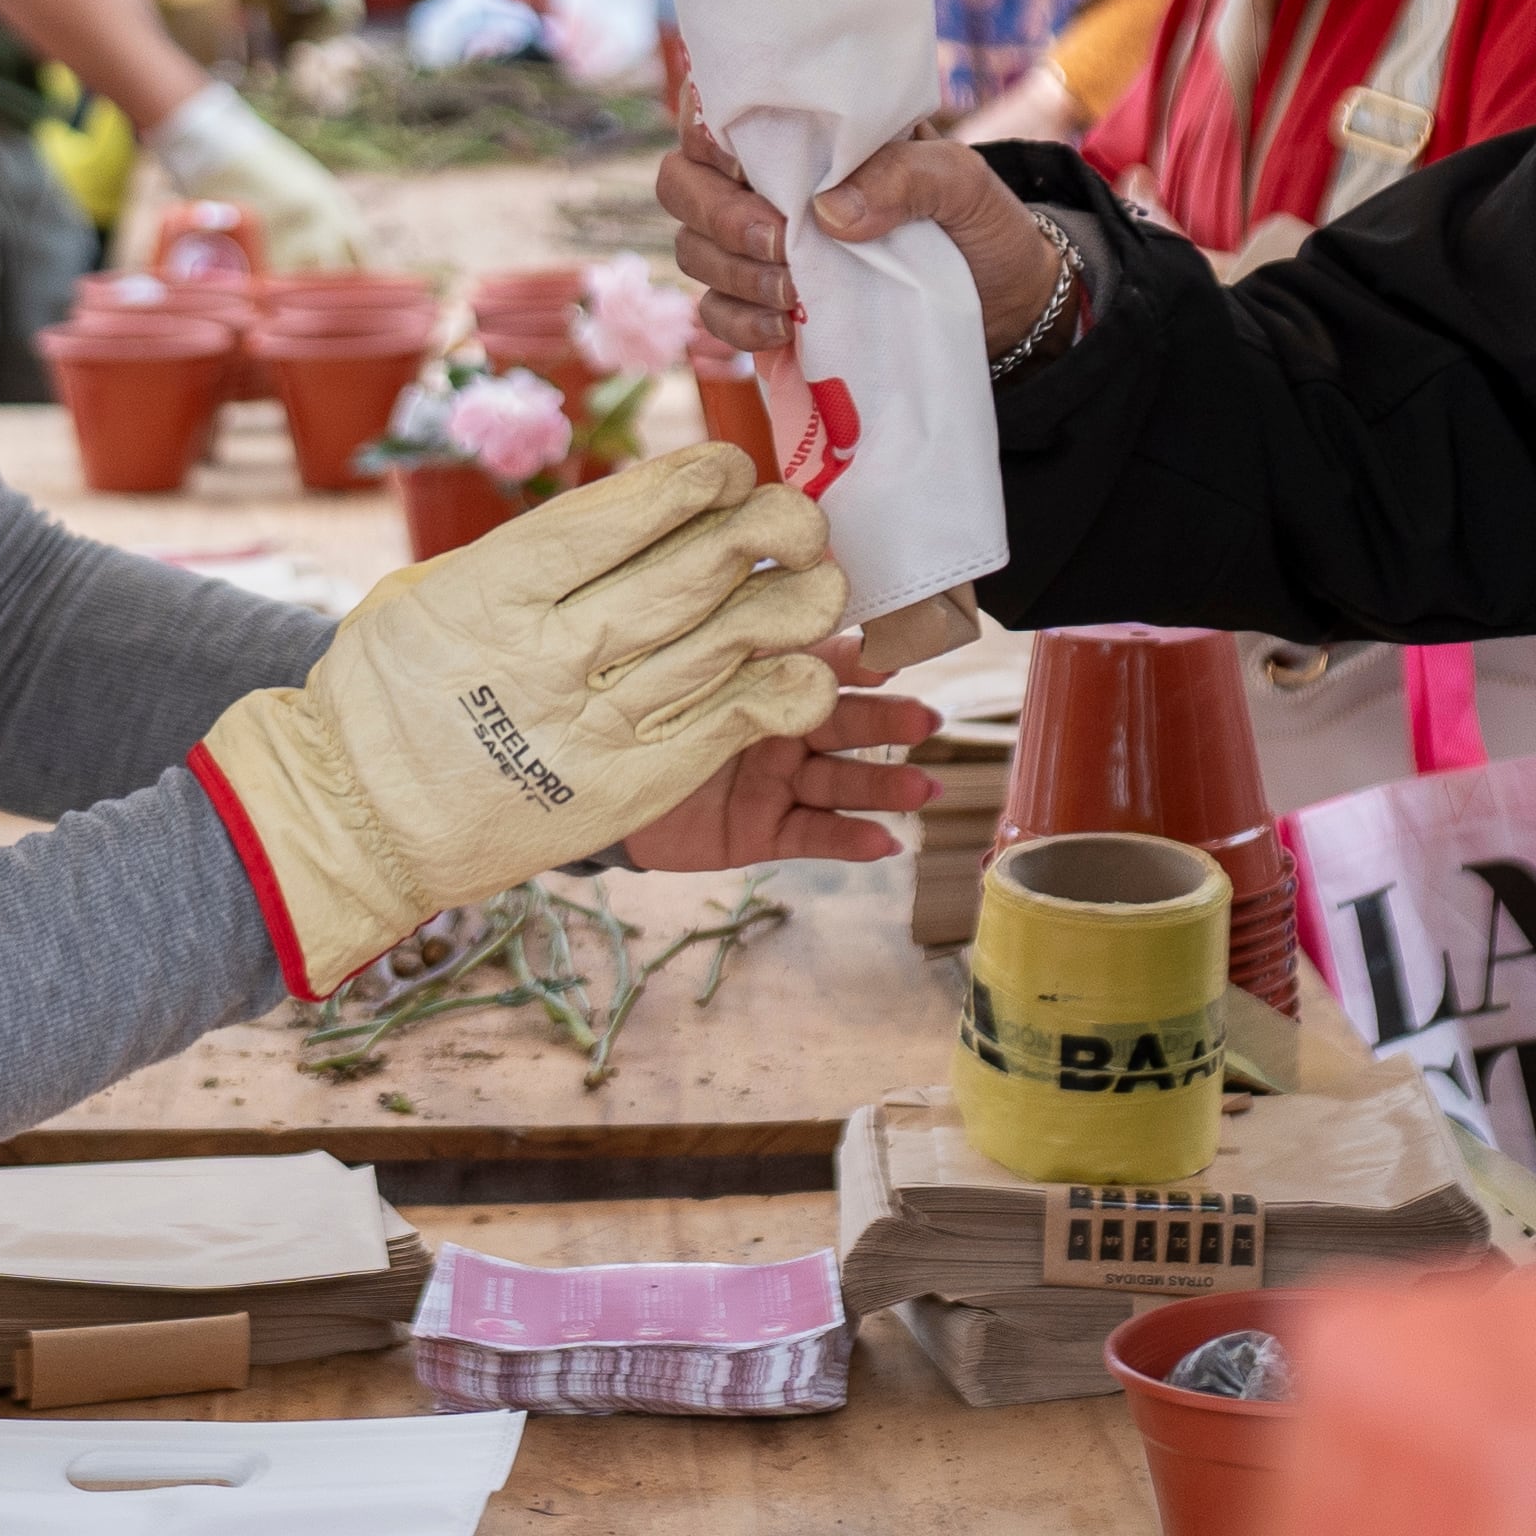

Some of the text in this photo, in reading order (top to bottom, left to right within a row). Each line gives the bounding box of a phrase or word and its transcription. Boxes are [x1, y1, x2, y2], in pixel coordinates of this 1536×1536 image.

[469, 685, 575, 805] STEELPRO
[1105, 1273, 1214, 1288] OTRAS MEDIDAS
